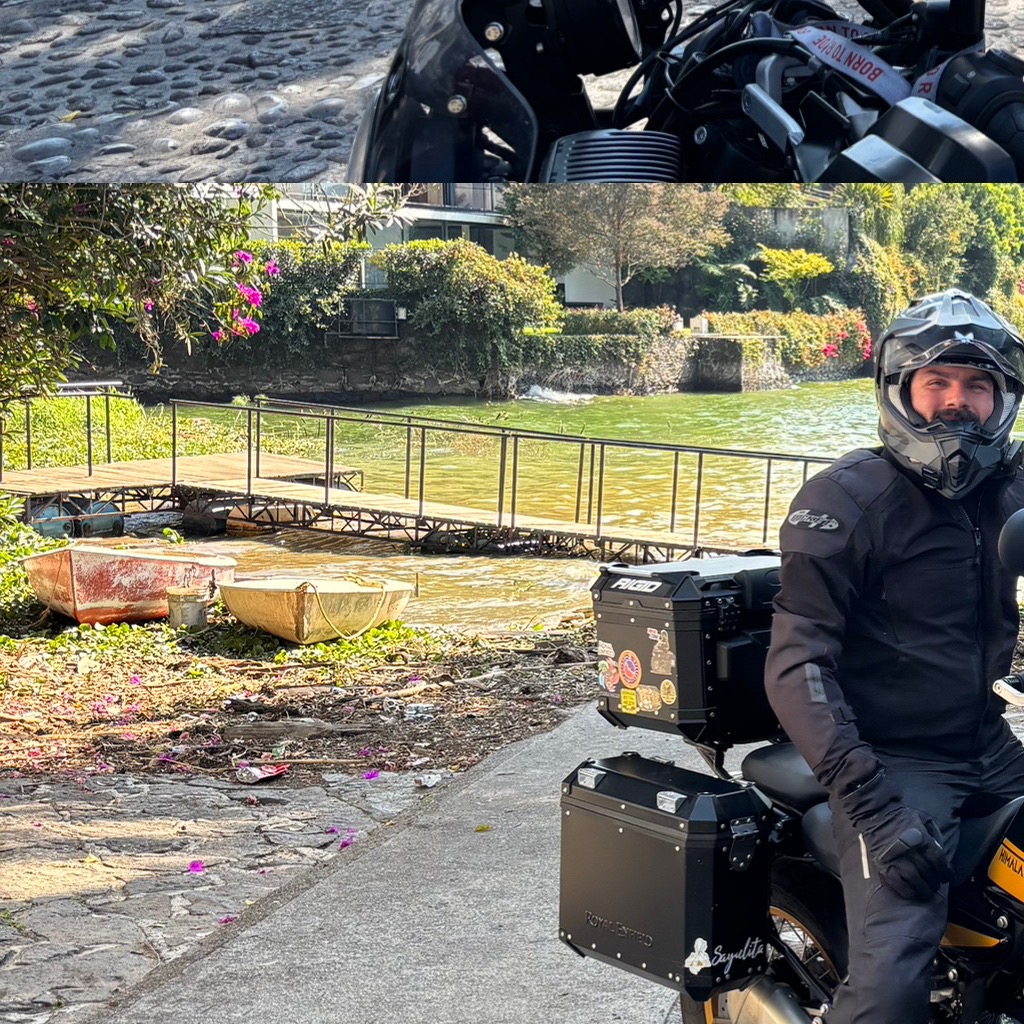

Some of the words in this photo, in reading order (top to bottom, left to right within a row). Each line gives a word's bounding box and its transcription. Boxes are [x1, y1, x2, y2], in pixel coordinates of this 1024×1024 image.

[812, 34, 833, 56] RIDE
[831, 45, 846, 62] TO
[844, 51, 884, 83] BORN
[610, 577, 664, 593] RIGID
[585, 910, 615, 933] ROYAL
[615, 921, 653, 947] ENFIELD
[711, 936, 765, 975] Sayulita
